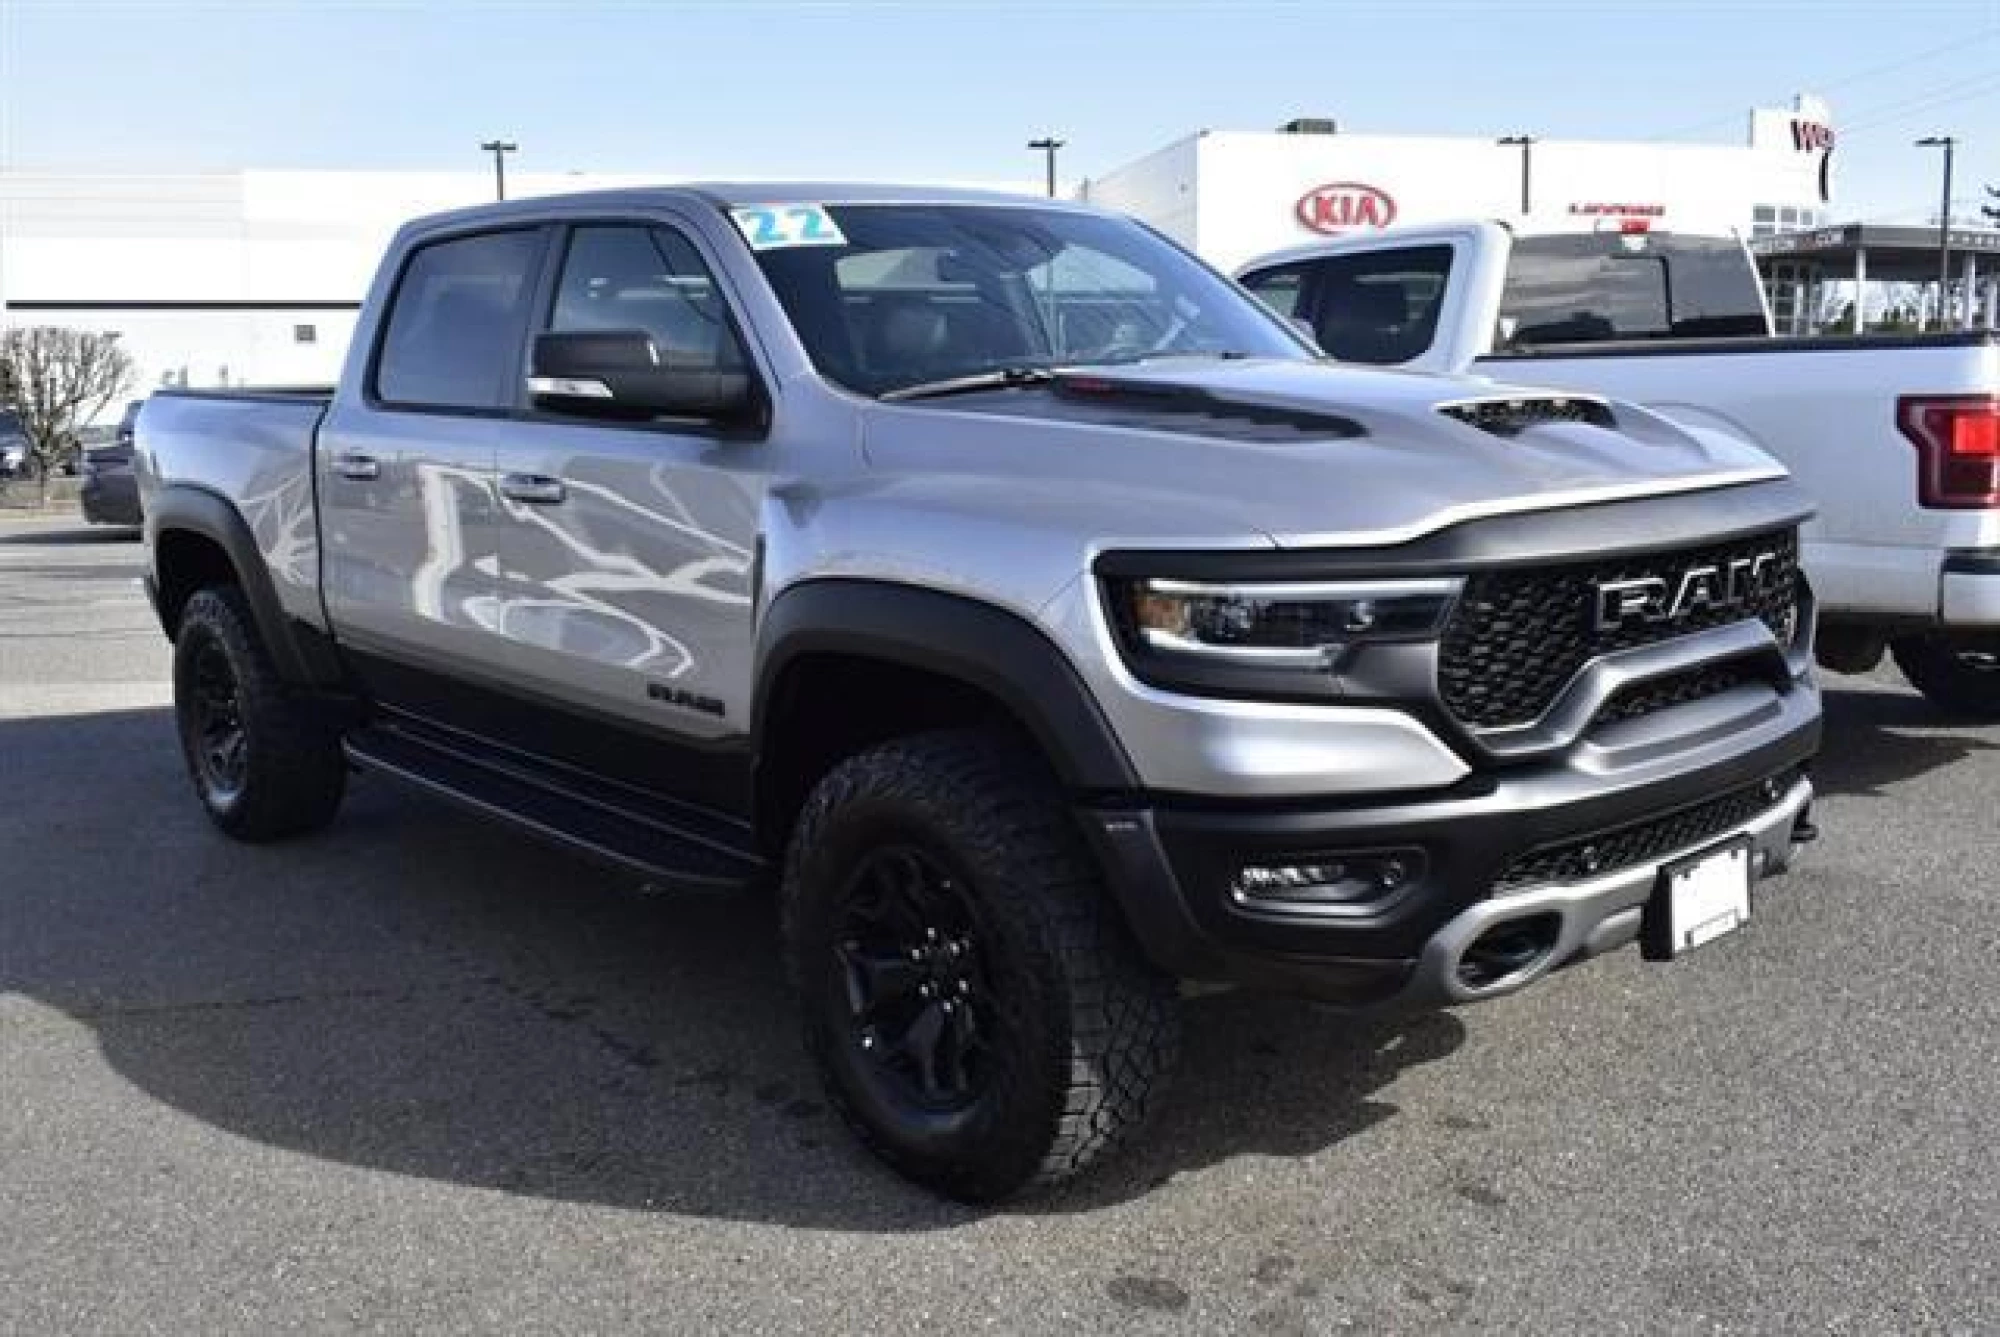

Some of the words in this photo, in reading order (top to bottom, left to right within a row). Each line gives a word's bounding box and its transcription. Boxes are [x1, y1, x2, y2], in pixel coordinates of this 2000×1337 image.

[740, 208, 835, 243] 22
[1315, 194, 1379, 226] KIA
[1596, 552, 1784, 631] RAM
